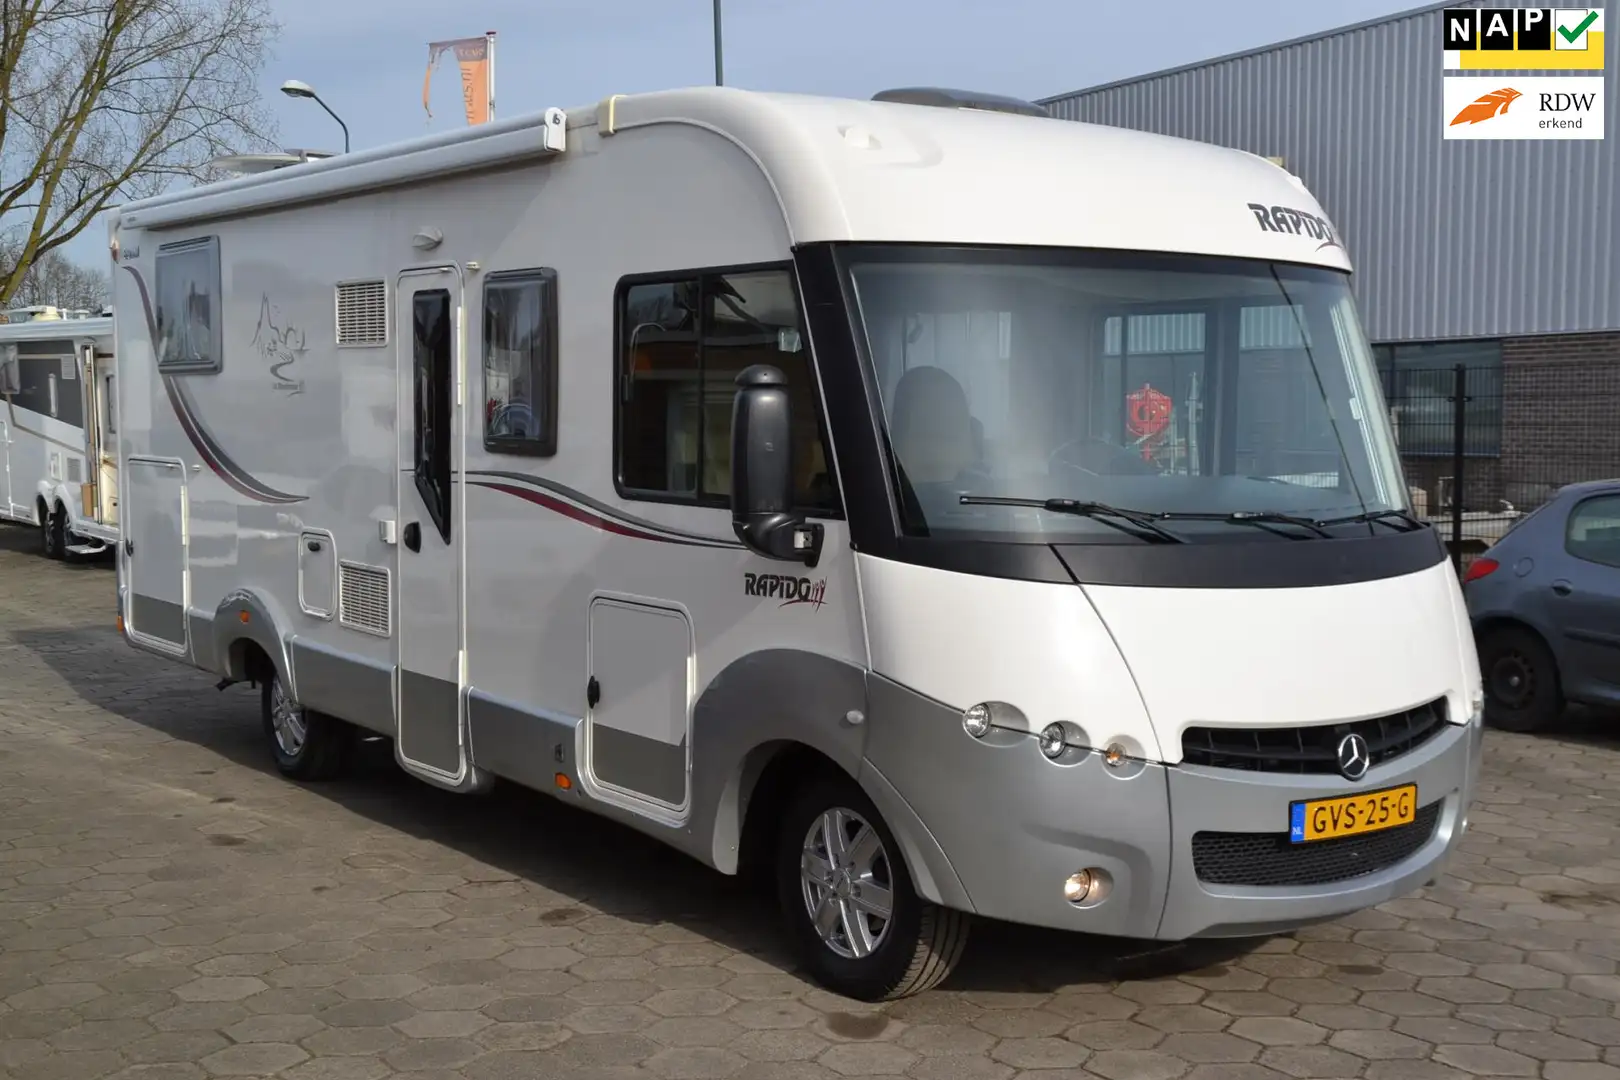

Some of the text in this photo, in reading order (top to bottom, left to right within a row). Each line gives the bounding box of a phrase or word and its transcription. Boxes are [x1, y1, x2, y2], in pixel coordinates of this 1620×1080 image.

[1247, 202, 1336, 244] RAPIDO
[744, 572, 811, 602] RAPIDO
[1312, 792, 1409, 834] GVS-25-G
